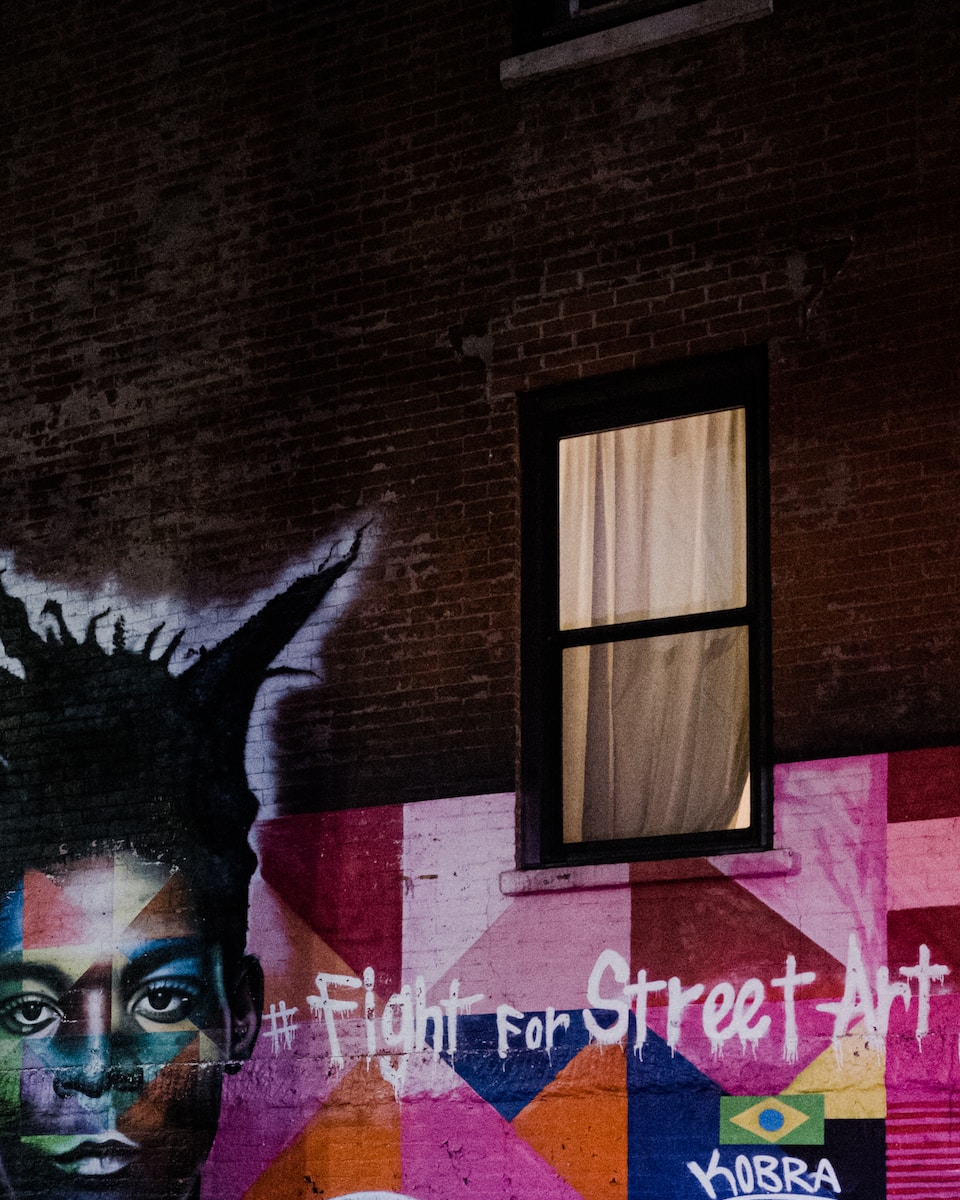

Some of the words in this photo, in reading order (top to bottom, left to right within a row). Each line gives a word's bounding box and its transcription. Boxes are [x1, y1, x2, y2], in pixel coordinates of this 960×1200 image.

[583, 949, 816, 1060] Street
[815, 933, 951, 1064] Art
[686, 1148, 842, 1199] KOBRA
